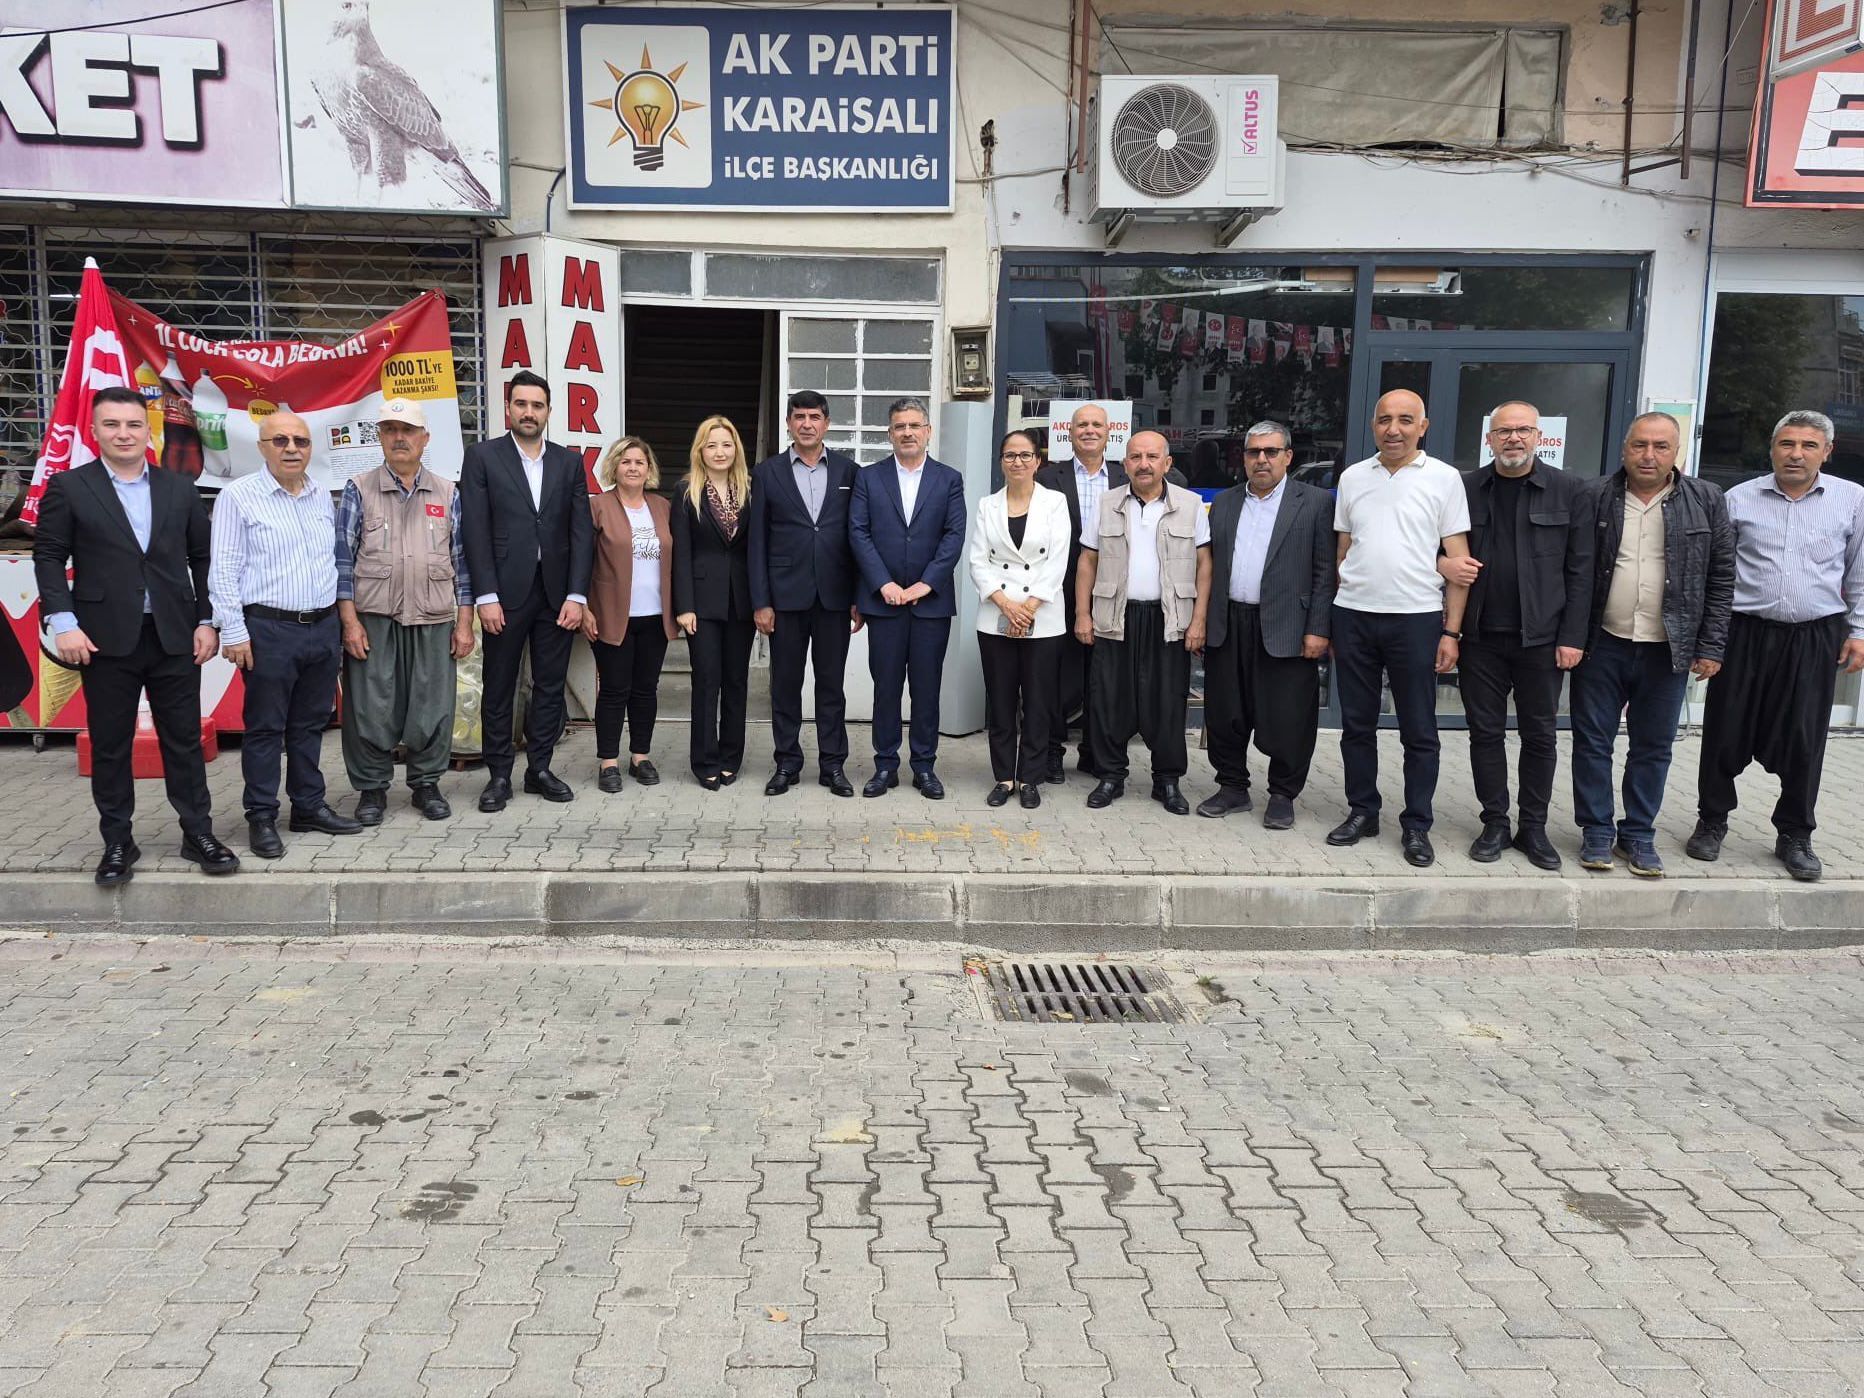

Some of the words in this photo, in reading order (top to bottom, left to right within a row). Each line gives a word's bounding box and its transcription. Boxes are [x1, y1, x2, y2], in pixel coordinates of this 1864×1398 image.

[721, 33, 792, 75] AK
[1244, 89, 1259, 140] ALTUS
[783, 154, 938, 181] BAŞKANLIĞI
[154, 323, 175, 348] 1L
[498, 253, 533, 431] MA
[384, 360, 415, 377] 1000
[392, 386, 420, 395] KAZANMA
[394, 379, 414, 387] KADAR
